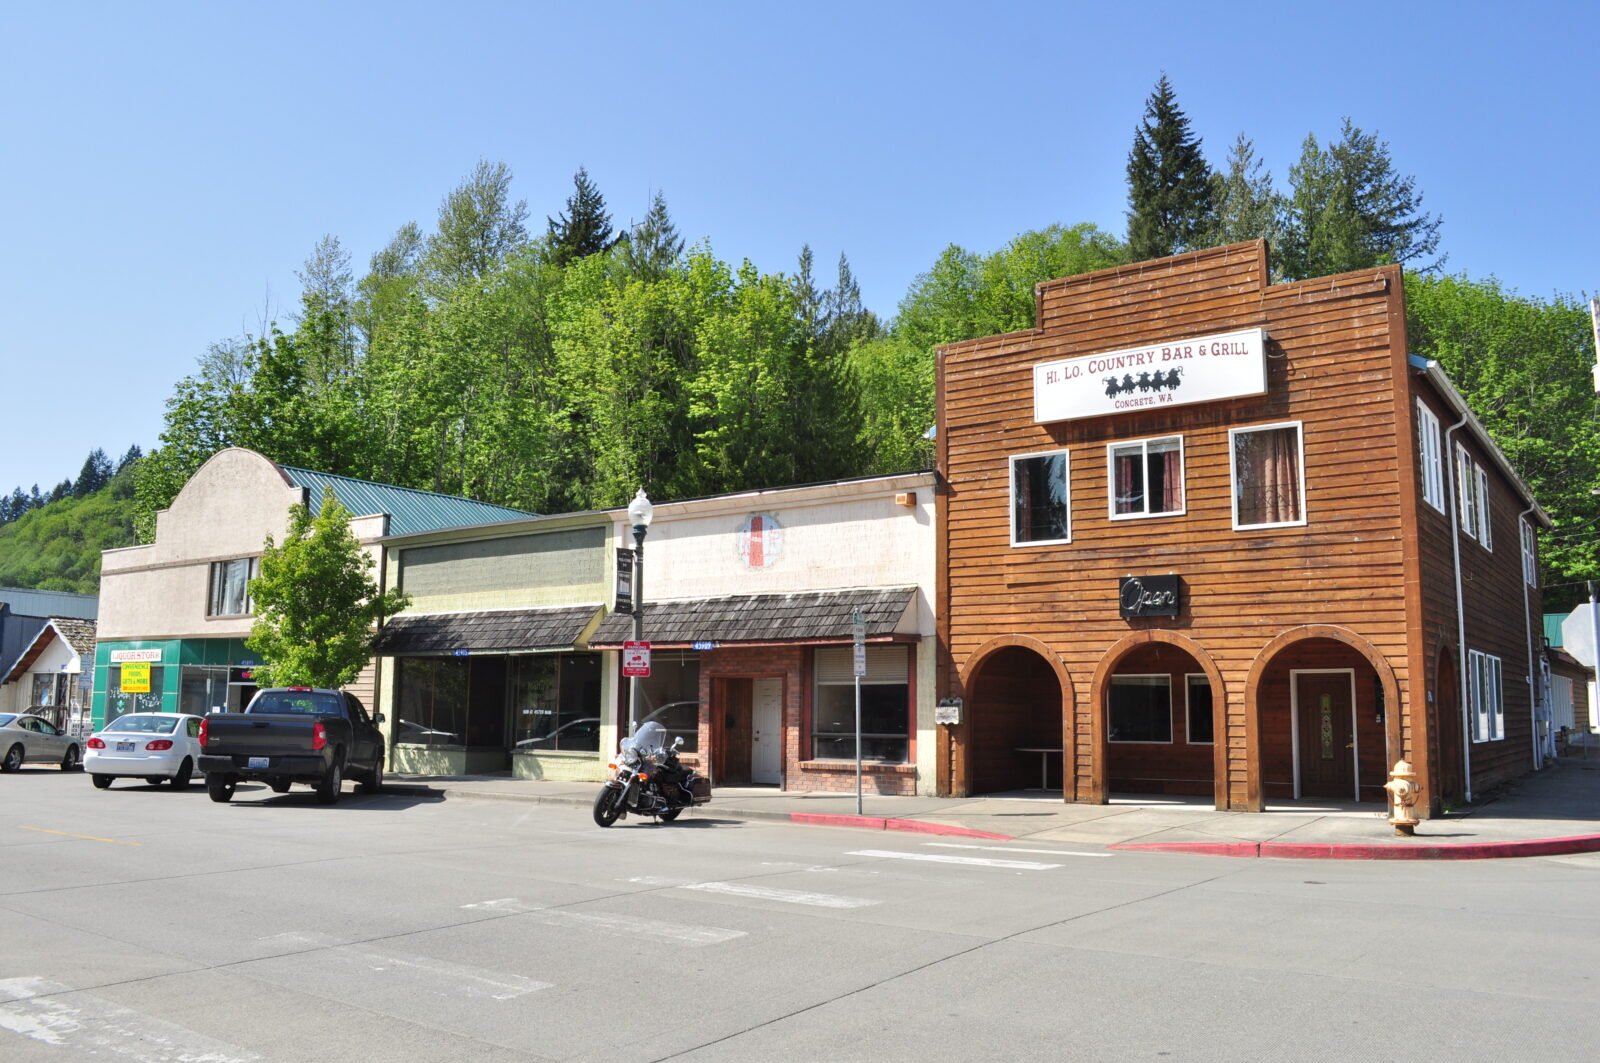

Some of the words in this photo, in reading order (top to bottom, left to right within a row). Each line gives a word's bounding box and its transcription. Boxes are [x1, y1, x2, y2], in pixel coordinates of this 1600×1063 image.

[1064, 365, 1083, 380] LO.
[1088, 351, 1155, 374] COUNTRY
[1161, 345, 1193, 362] BAR
[1199, 345, 1207, 356] &
[1211, 342, 1249, 357] GRILL
[1158, 393, 1173, 403] WA
[1120, 577, 1175, 614] Open
[113, 651, 135, 660] LIQUOR
[136, 651, 160, 659] STORE
